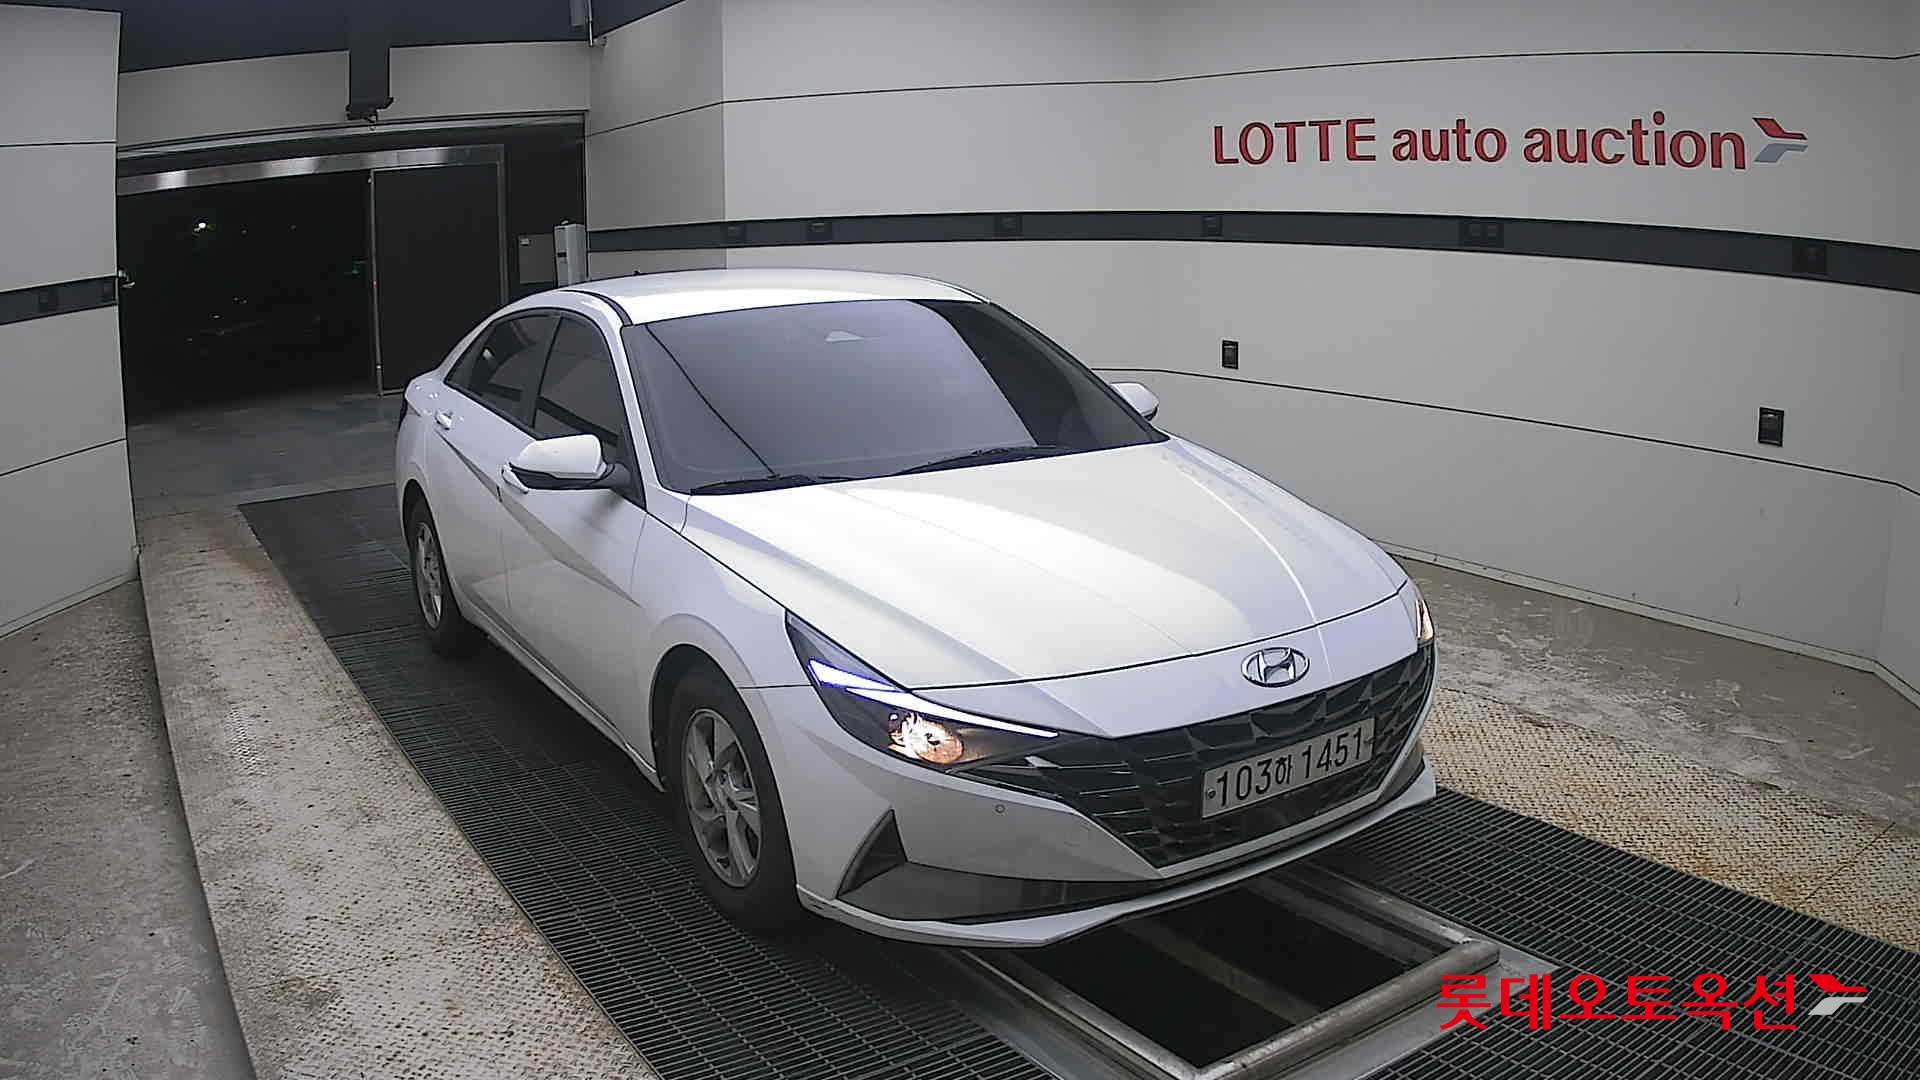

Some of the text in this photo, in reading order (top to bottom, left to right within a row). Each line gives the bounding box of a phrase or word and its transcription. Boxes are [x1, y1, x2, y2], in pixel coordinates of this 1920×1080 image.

[1213, 111, 1746, 170] LOTTE auto auction
[1216, 727, 1362, 807] 103하 1451
